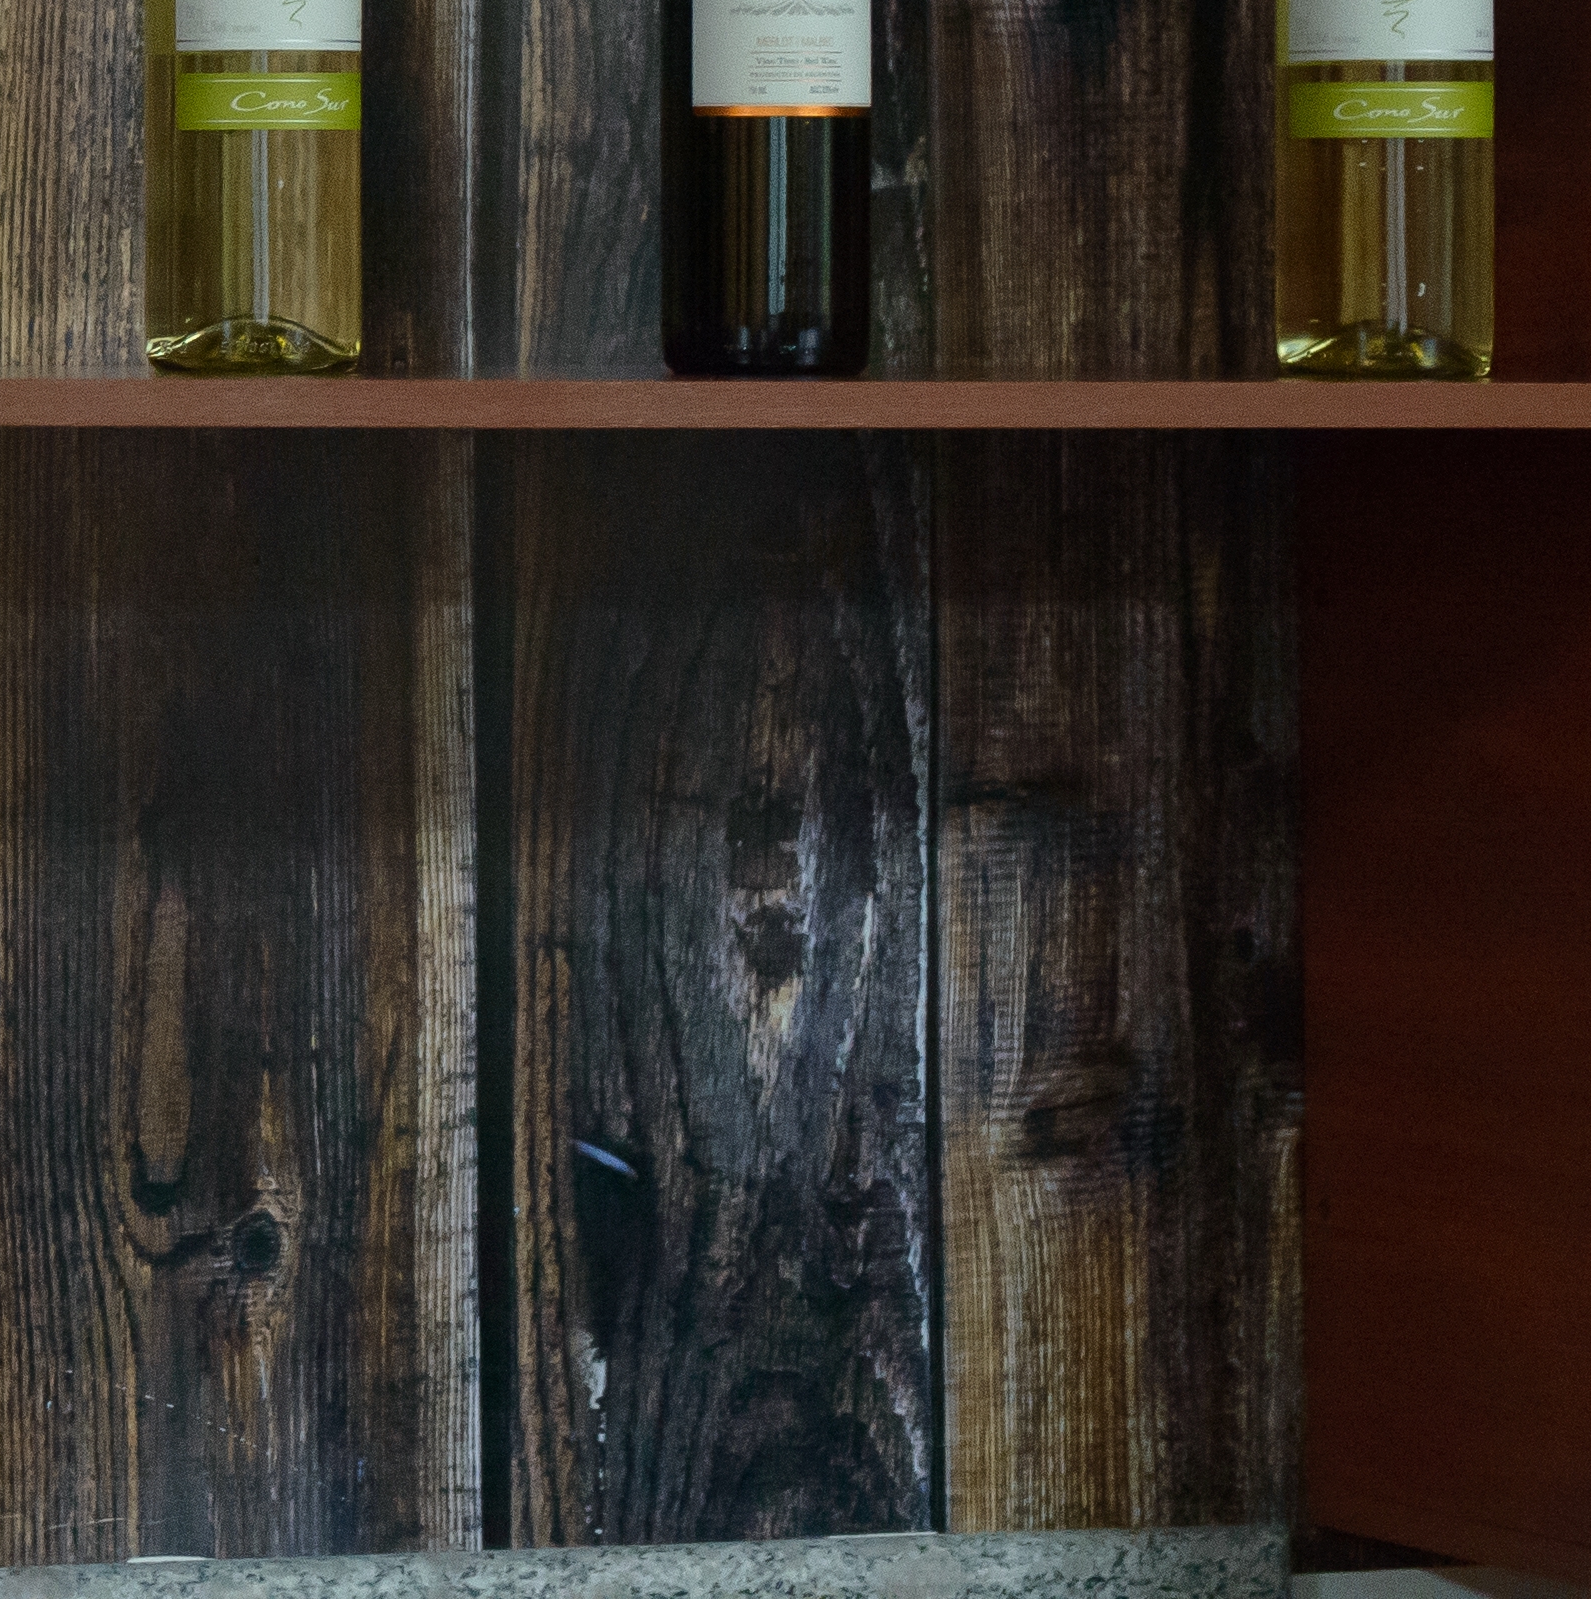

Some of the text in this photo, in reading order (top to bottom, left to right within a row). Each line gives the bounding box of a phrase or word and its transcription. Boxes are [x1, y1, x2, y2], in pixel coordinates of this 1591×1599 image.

[230, 87, 349, 116] Cono Sur
[1333, 97, 1465, 123] Cono Sur
